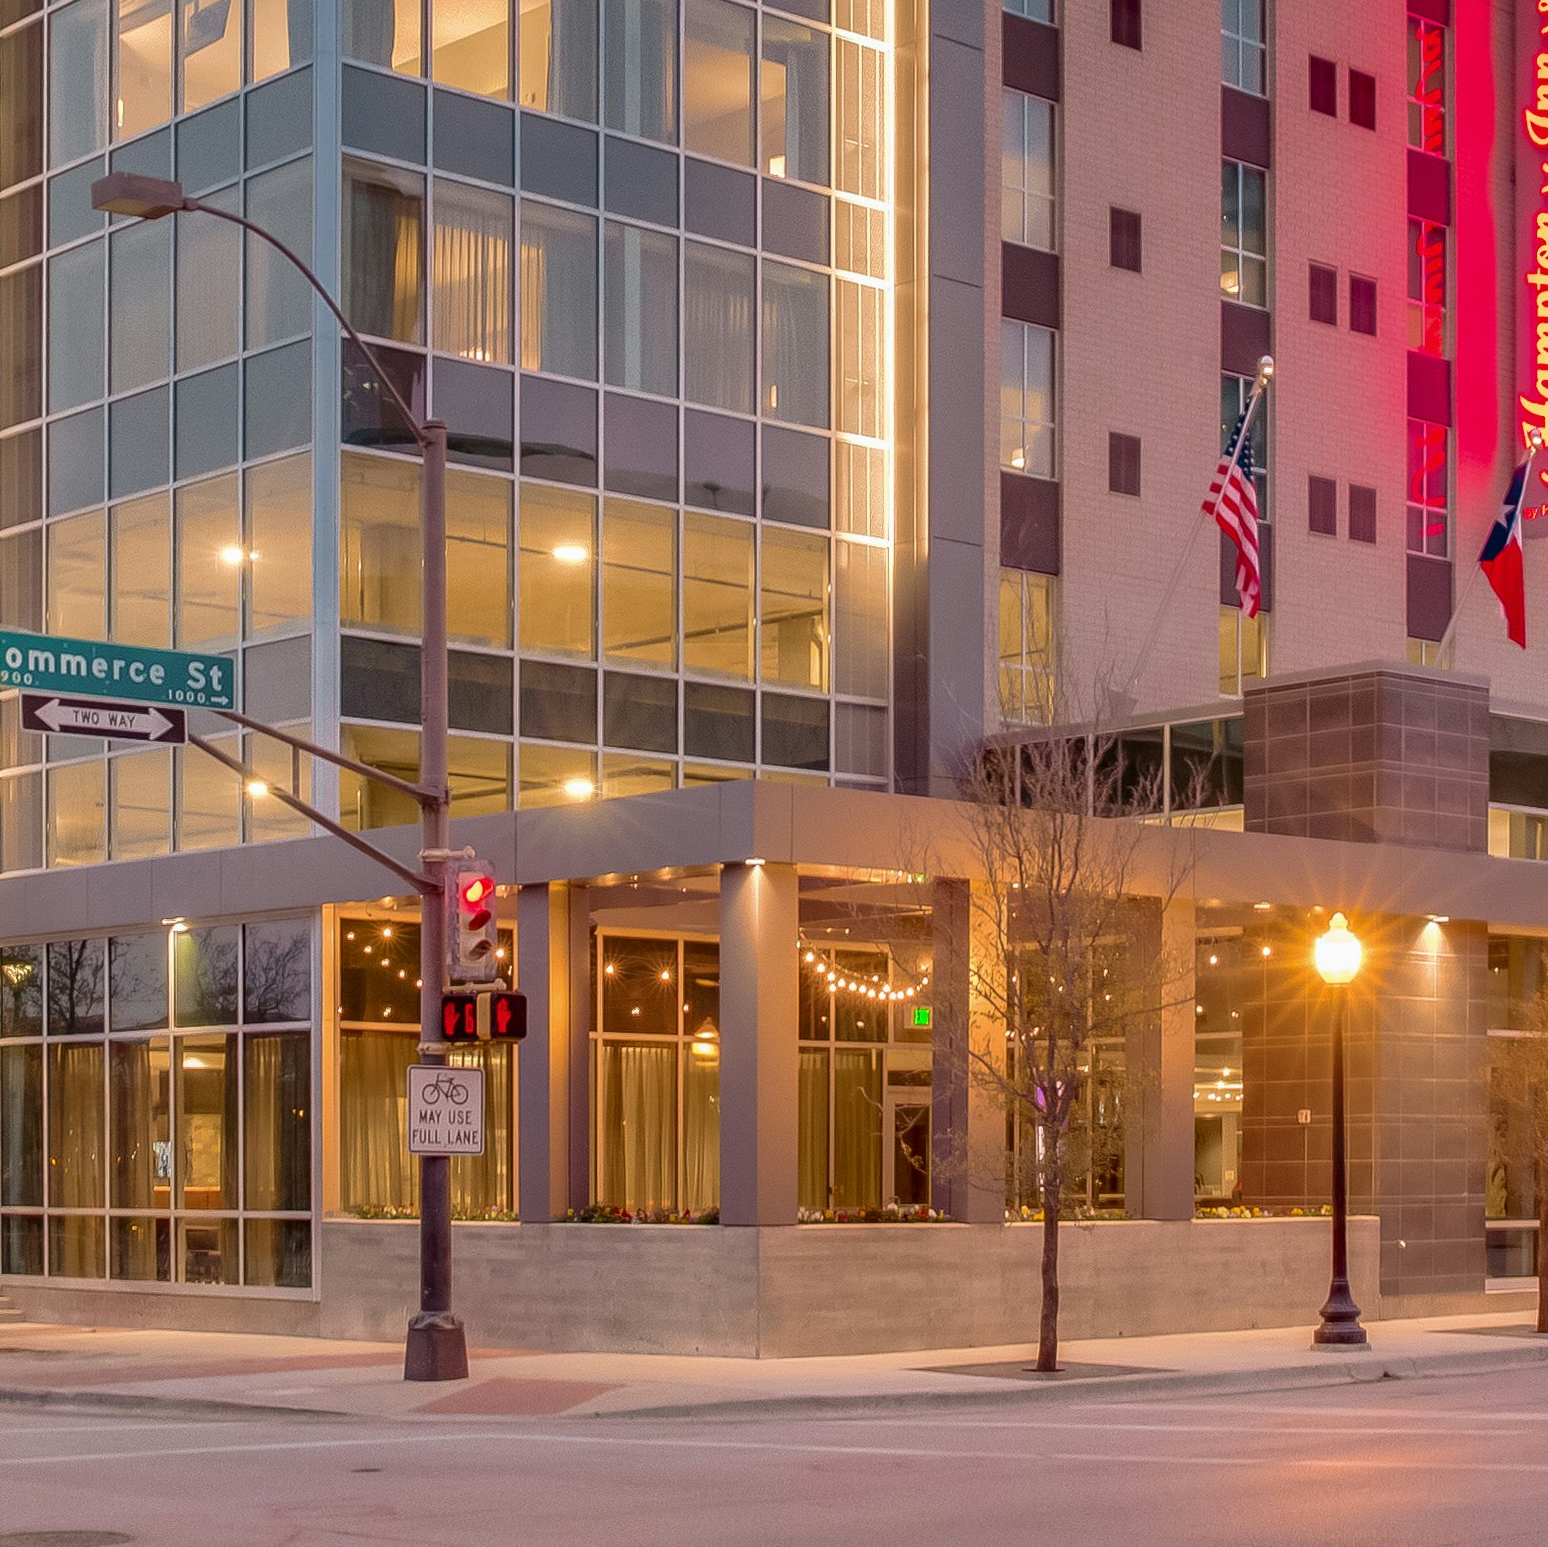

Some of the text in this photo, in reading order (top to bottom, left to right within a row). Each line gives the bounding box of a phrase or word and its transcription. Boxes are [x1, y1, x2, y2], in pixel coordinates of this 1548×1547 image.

[187, 661, 223, 692] St
[0, 670, 205, 704] 900 1000
[72, 709, 136, 729] TWO WAY
[418, 1109, 473, 1125] MAY USE
[412, 1129, 479, 1145] FULL LANE
